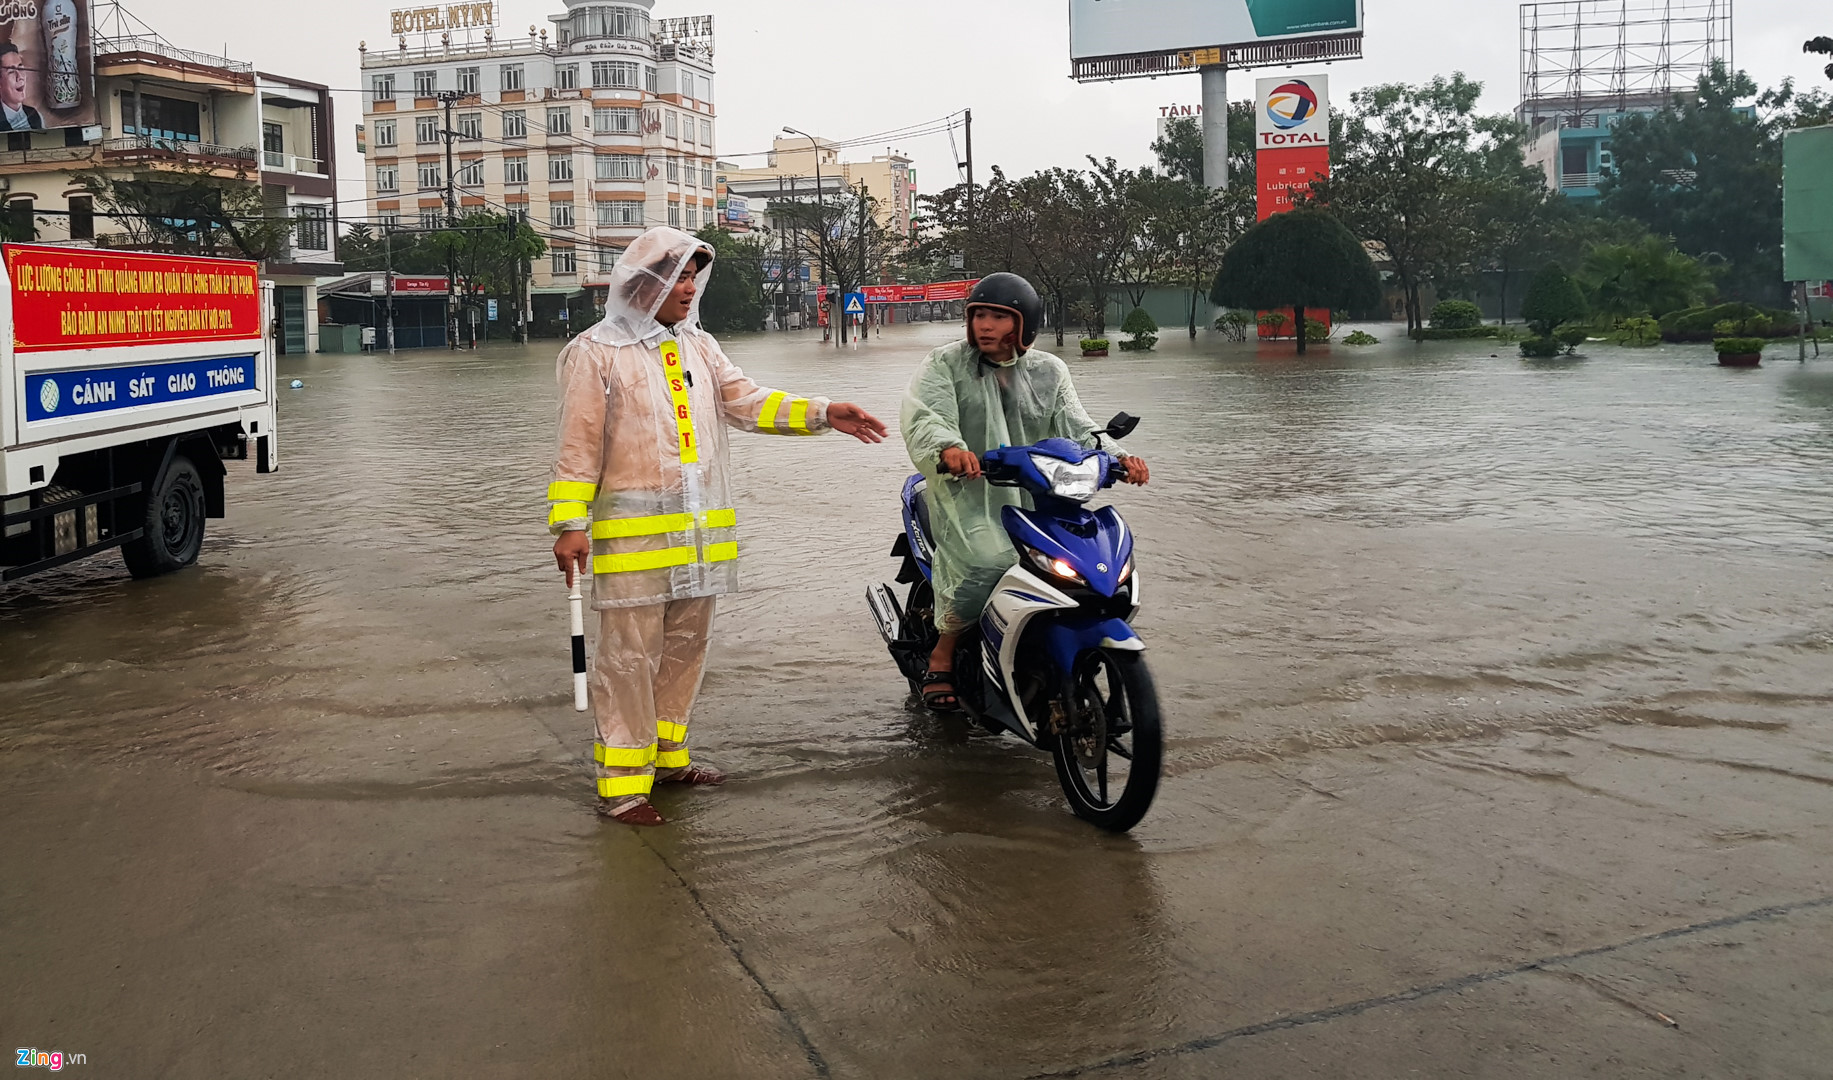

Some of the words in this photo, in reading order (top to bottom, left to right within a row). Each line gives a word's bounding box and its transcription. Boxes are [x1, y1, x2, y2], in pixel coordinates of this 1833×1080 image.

[391, 8, 445, 34] HOTEL
[1159, 102, 1192, 117] TÂN
[1259, 132, 1326, 145] TOTAL
[1266, 180, 1311, 191] Lubrican
[17, 263, 34, 297] LỰC
[35, 264, 62, 297] LƯỢNG
[63, 262, 84, 292] CÔNG
[86, 269, 97, 292] AN
[98, 261, 114, 293] TỈNH
[115, 262, 138, 296] QUẢNG
[139, 270, 154, 293] NAM
[155, 271, 164, 293] RA
[164, 267, 181, 296] QUÂN
[193, 269, 208, 294] CÔNG
[61, 302, 77, 335] BẢO
[97, 311, 107, 334] AN
[108, 310, 126, 334] NINH
[72, 377, 116, 405] CẢNH
[129, 372, 155, 398] SÁT
[167, 372, 196, 393] GIAO
[206, 365, 244, 388] THÔNG
[665, 352, 691, 448] CSGT
